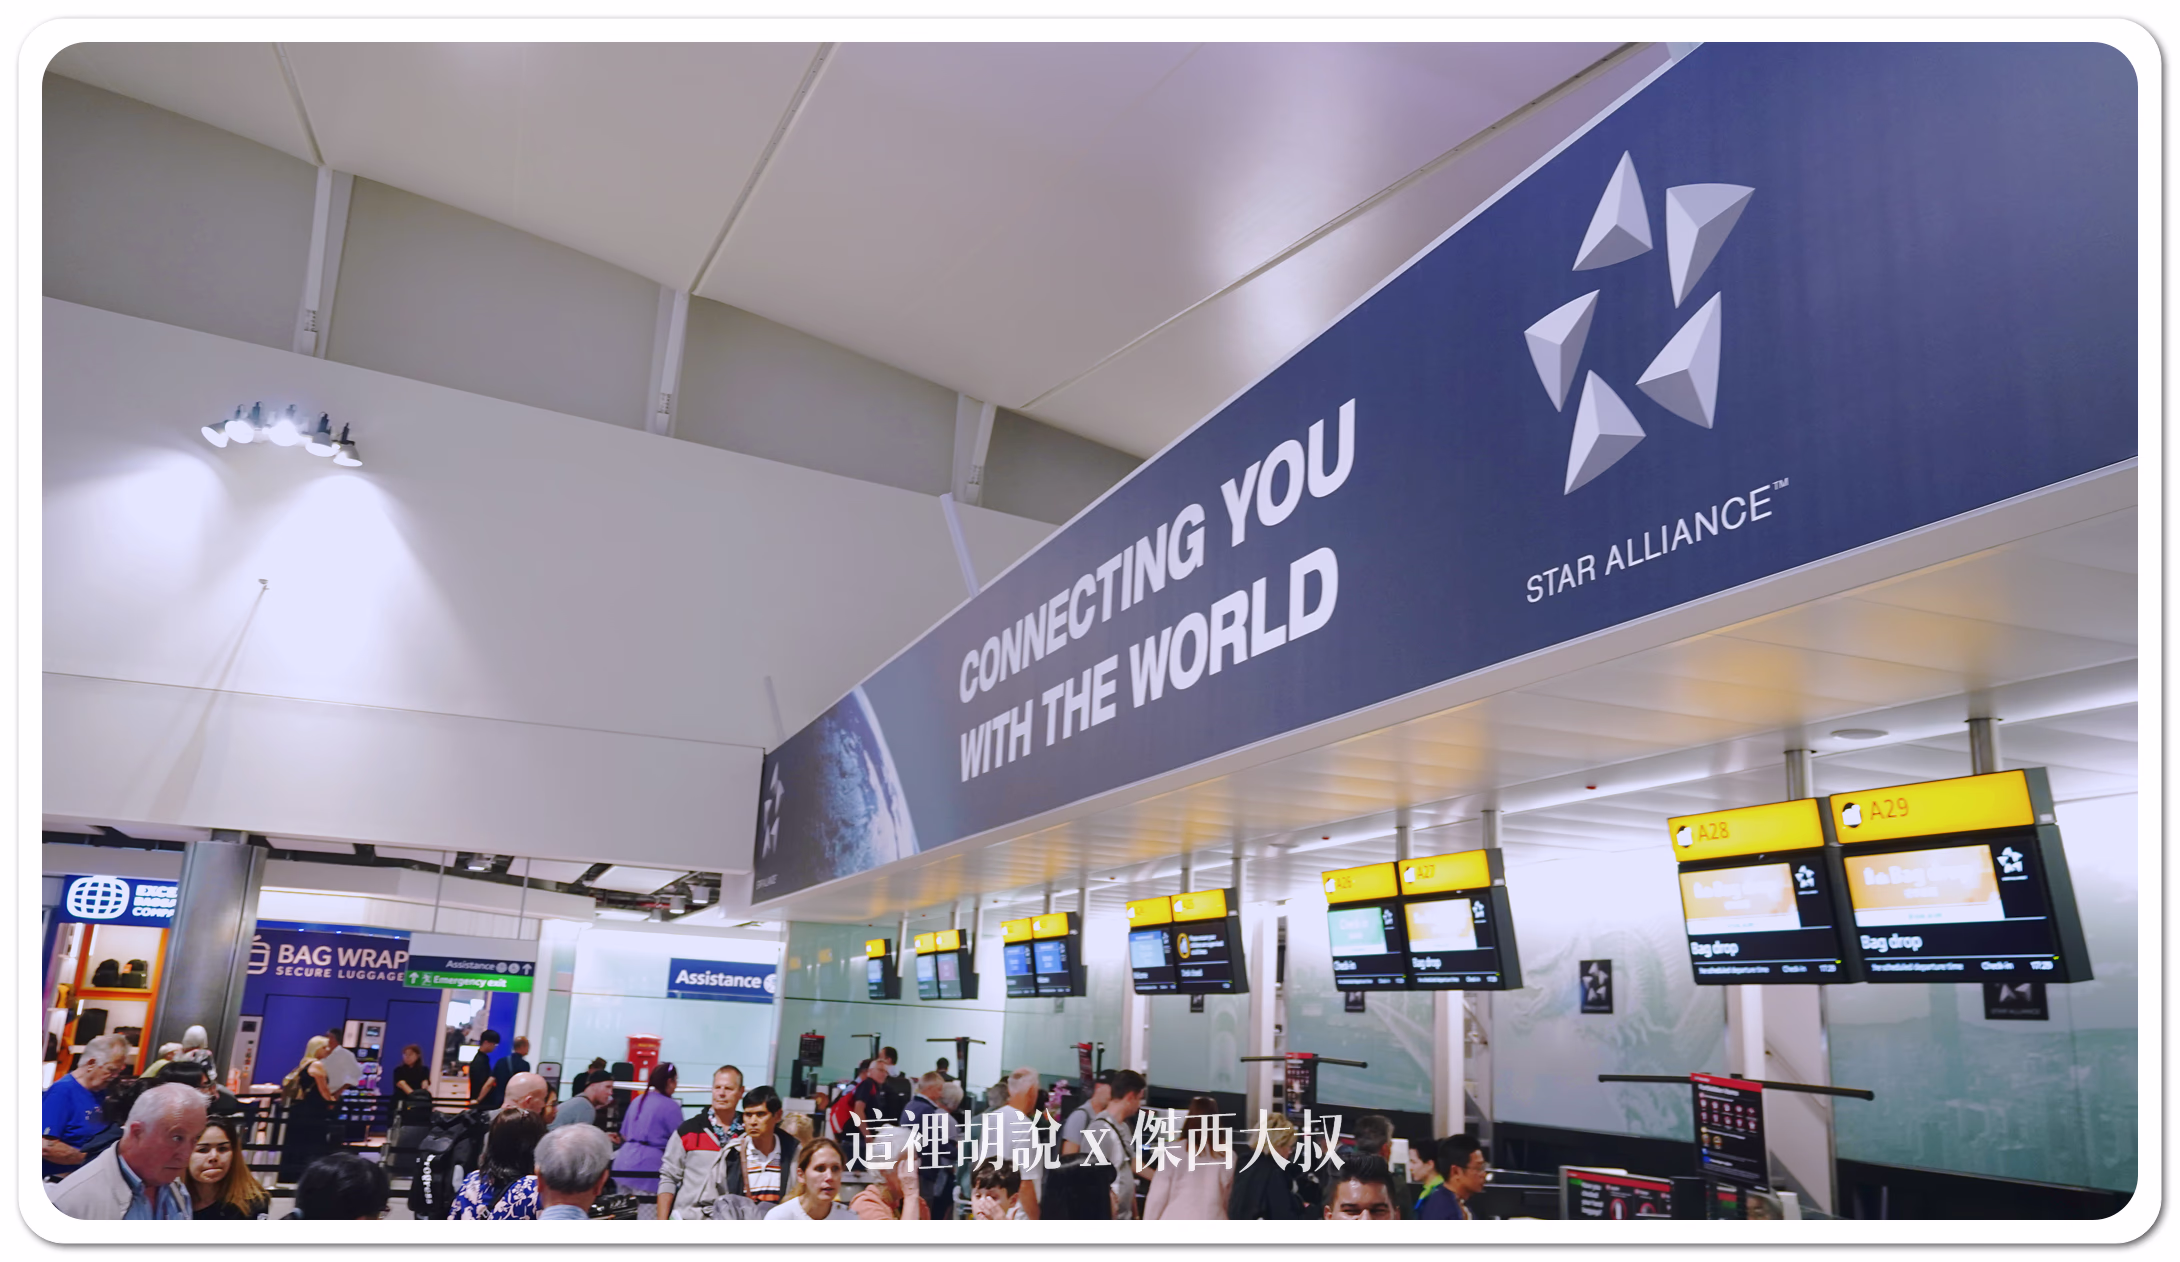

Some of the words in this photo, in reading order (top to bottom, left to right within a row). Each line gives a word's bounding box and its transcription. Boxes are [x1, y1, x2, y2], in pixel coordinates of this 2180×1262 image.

[959, 503, 1206, 703] CONNECTING
[1220, 398, 1356, 547] YOU
[1526, 554, 1596, 603] STAR
[960, 699, 1034, 782] WITH
[1042, 654, 1118, 746] THE
[1129, 547, 1339, 708] WORLD
[1870, 797, 1909, 820] A29
[1699, 821, 1729, 841] A28
[1690, 941, 1712, 958] Bag
[1712, 939, 1739, 957] drop
[1860, 934, 1888, 953] Bag
[1888, 932, 1923, 951] drop
[278, 944, 332, 966] BAG
[337, 947, 409, 969] WRAP
[445, 960, 496, 971] Assistance
[275, 966, 332, 978] SECURE
[337, 969, 405, 981] LUGGAGE
[433, 975, 486, 988] Emergency
[487, 978, 508, 987] exit
[675, 969, 762, 989] Assistance
